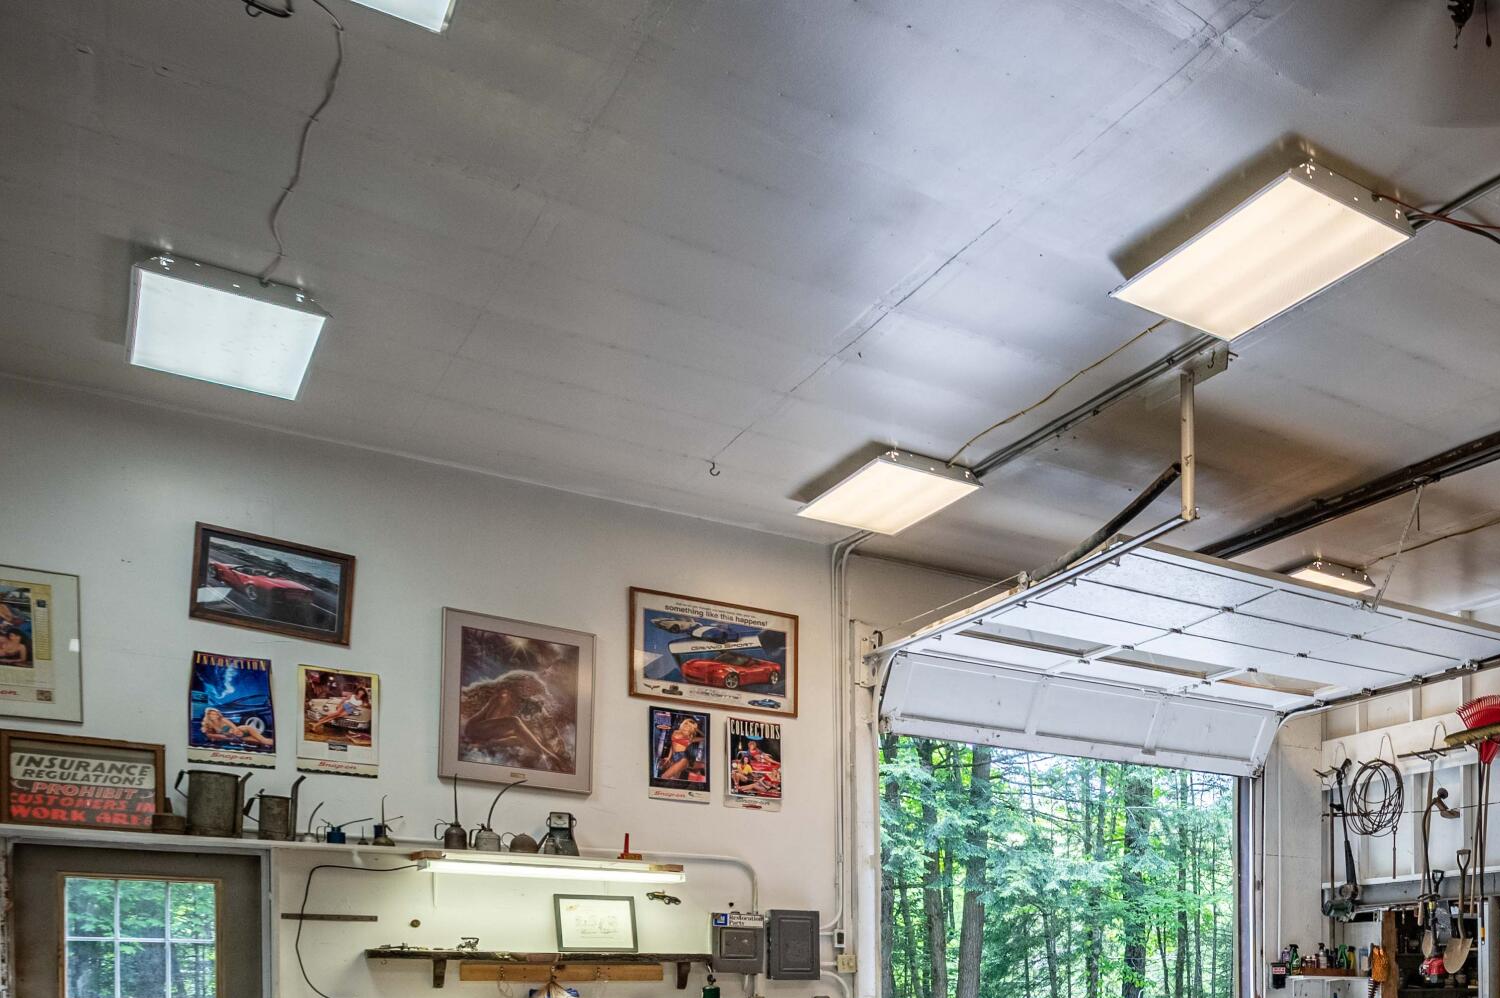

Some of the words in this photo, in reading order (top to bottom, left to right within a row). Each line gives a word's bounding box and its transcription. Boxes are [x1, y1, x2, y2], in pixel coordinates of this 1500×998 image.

[664, 604, 704, 618] something
[705, 611, 719, 619] like
[720, 613, 734, 622] this
[735, 615, 768, 627] happens!
[196, 652, 267, 672] INNOVATION
[730, 719, 780, 740] COLLECTORS
[15, 754, 151, 777] INSURANCE
[22, 768, 145, 786] REGULATIONS
[31, 781, 139, 800] PROHIBIT
[10, 792, 127, 811] CUSTOMERS
[136, 801, 156, 813] IN
[10, 804, 87, 822] WORK
